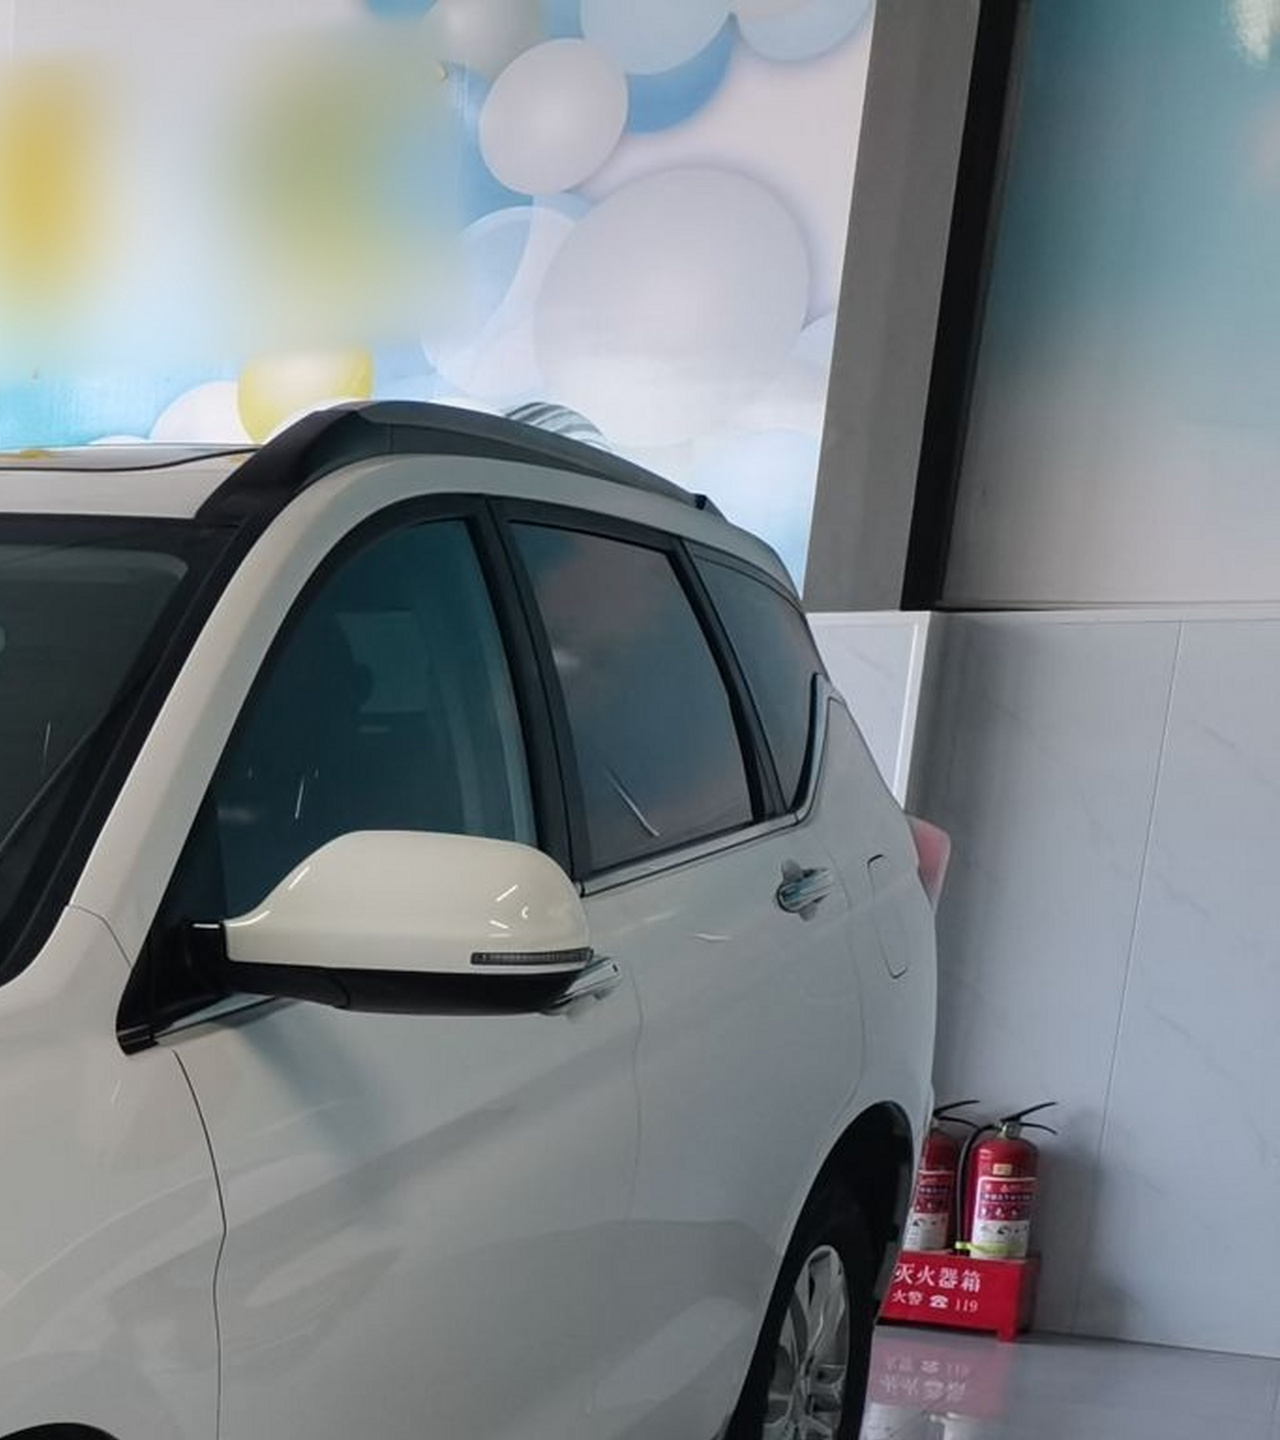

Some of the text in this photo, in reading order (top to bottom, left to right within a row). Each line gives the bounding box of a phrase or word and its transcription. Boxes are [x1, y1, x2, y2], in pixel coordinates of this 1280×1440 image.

[894, 1263, 981, 1293] 灭火器箱
[892, 1289, 979, 1313] 火警 119
